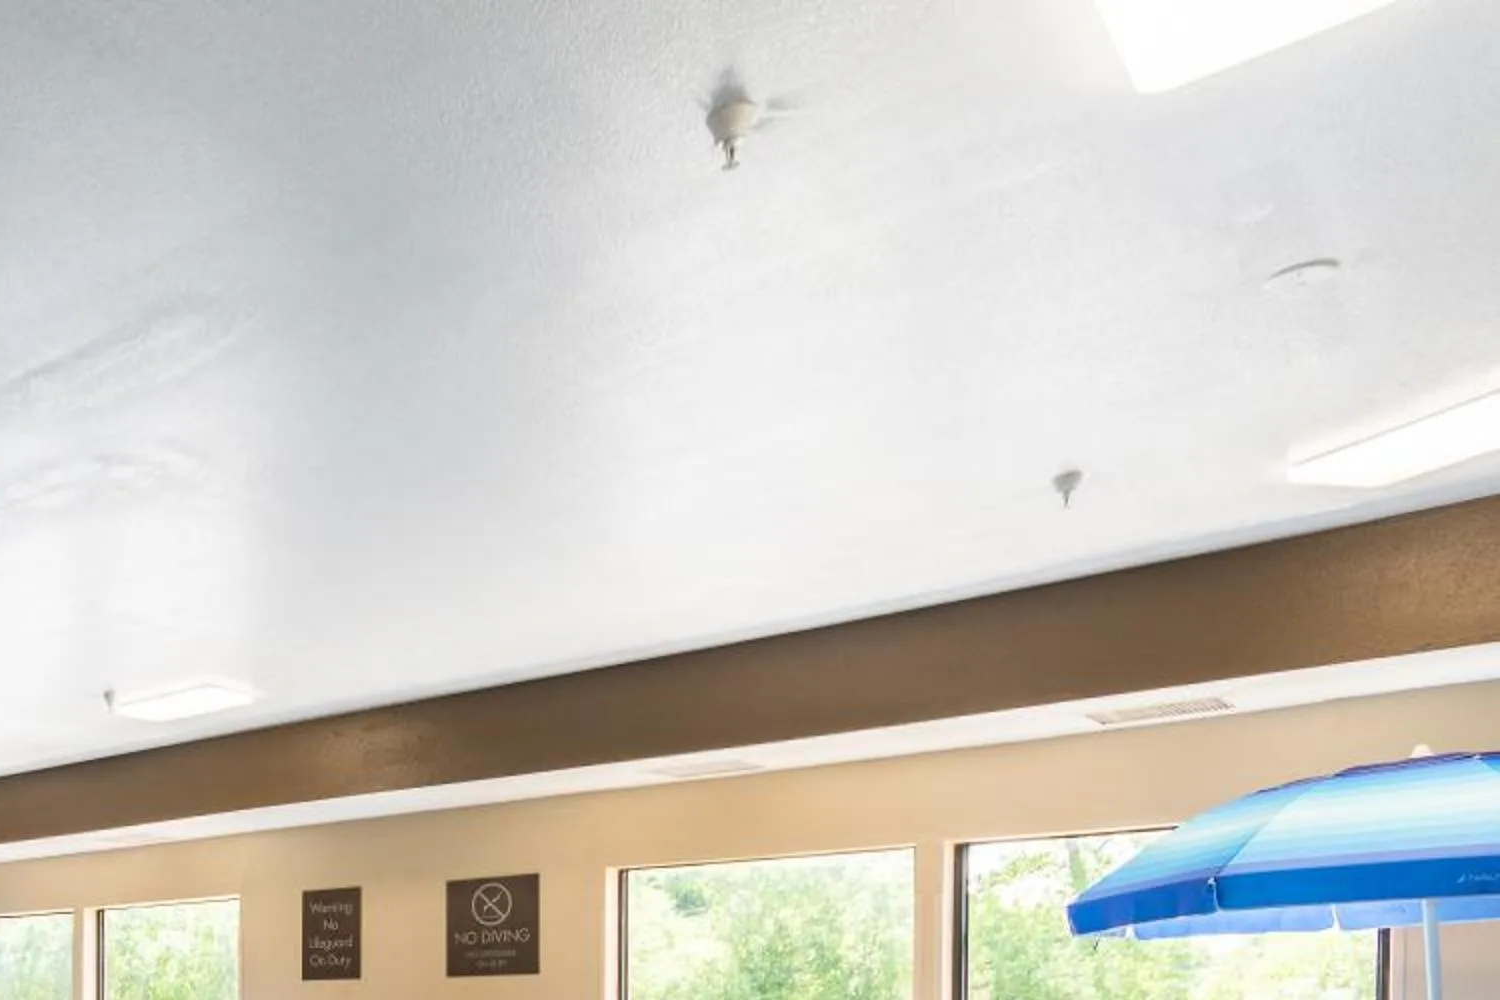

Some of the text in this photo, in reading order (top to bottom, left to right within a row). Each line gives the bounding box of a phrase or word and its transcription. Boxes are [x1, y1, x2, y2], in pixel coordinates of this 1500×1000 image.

[322, 917, 339, 931] No
[453, 927, 531, 947] NO DIVING
